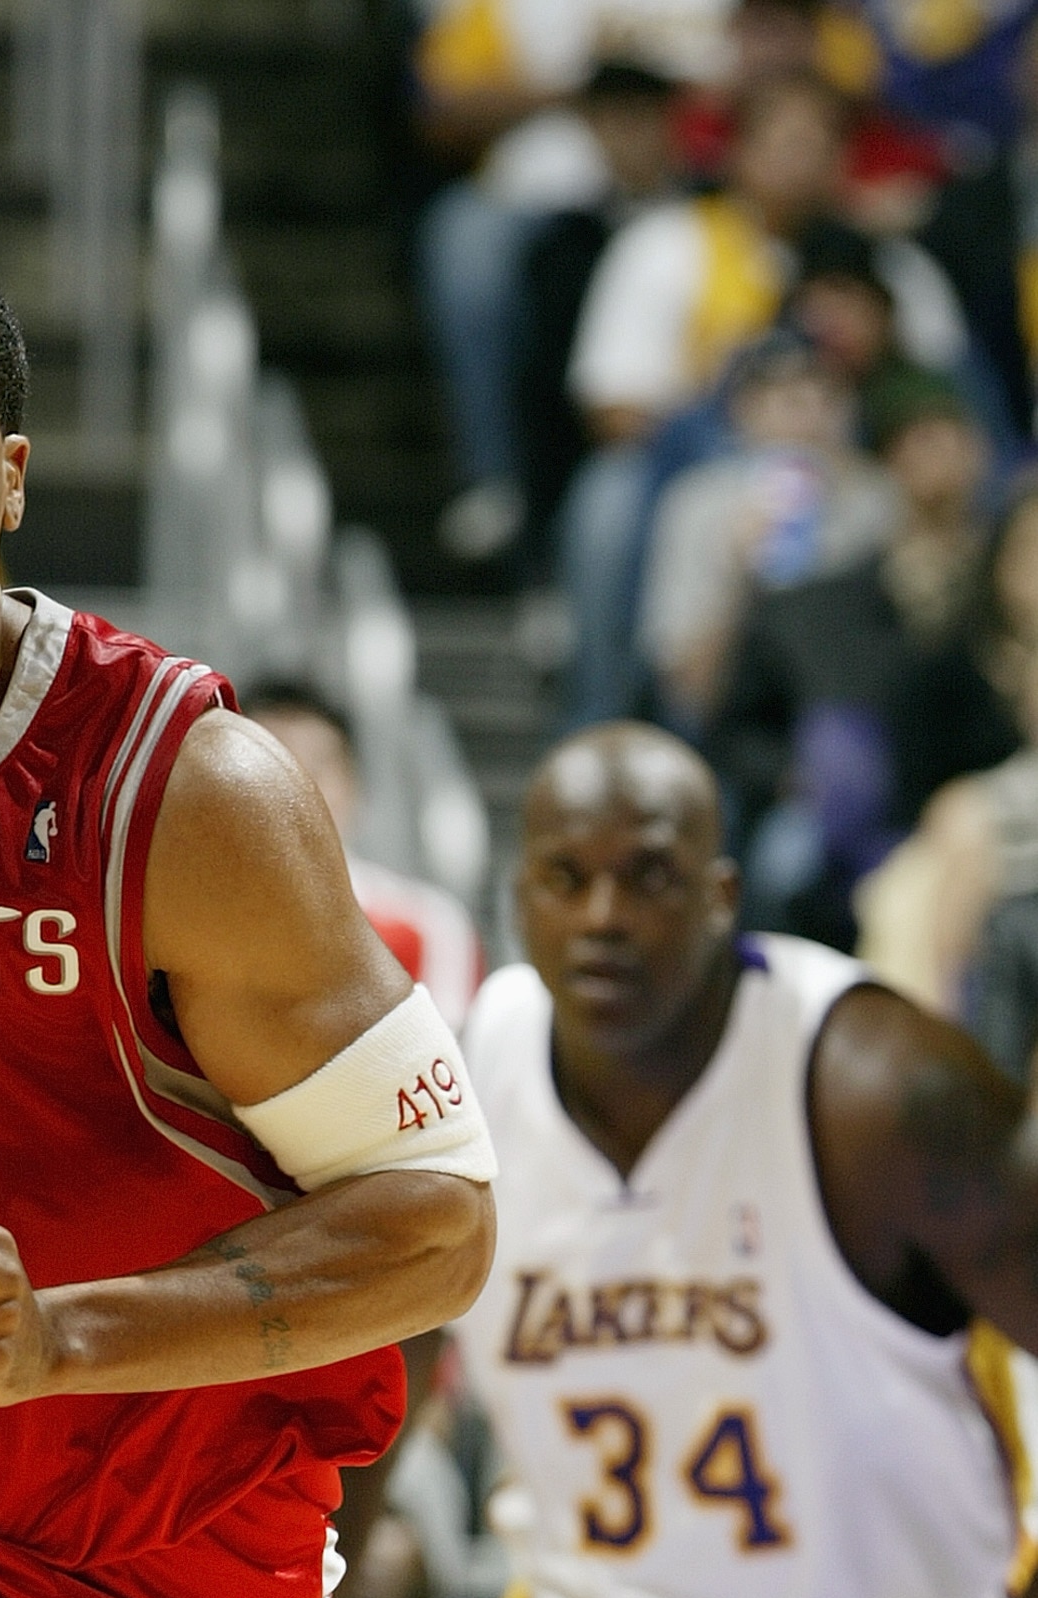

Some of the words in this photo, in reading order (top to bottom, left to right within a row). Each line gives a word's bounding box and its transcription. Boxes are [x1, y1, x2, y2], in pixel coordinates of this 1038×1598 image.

[397, 1057, 462, 1131] 419
[504, 1269, 769, 1364] LAKERS
[562, 1396, 790, 1554] 34
